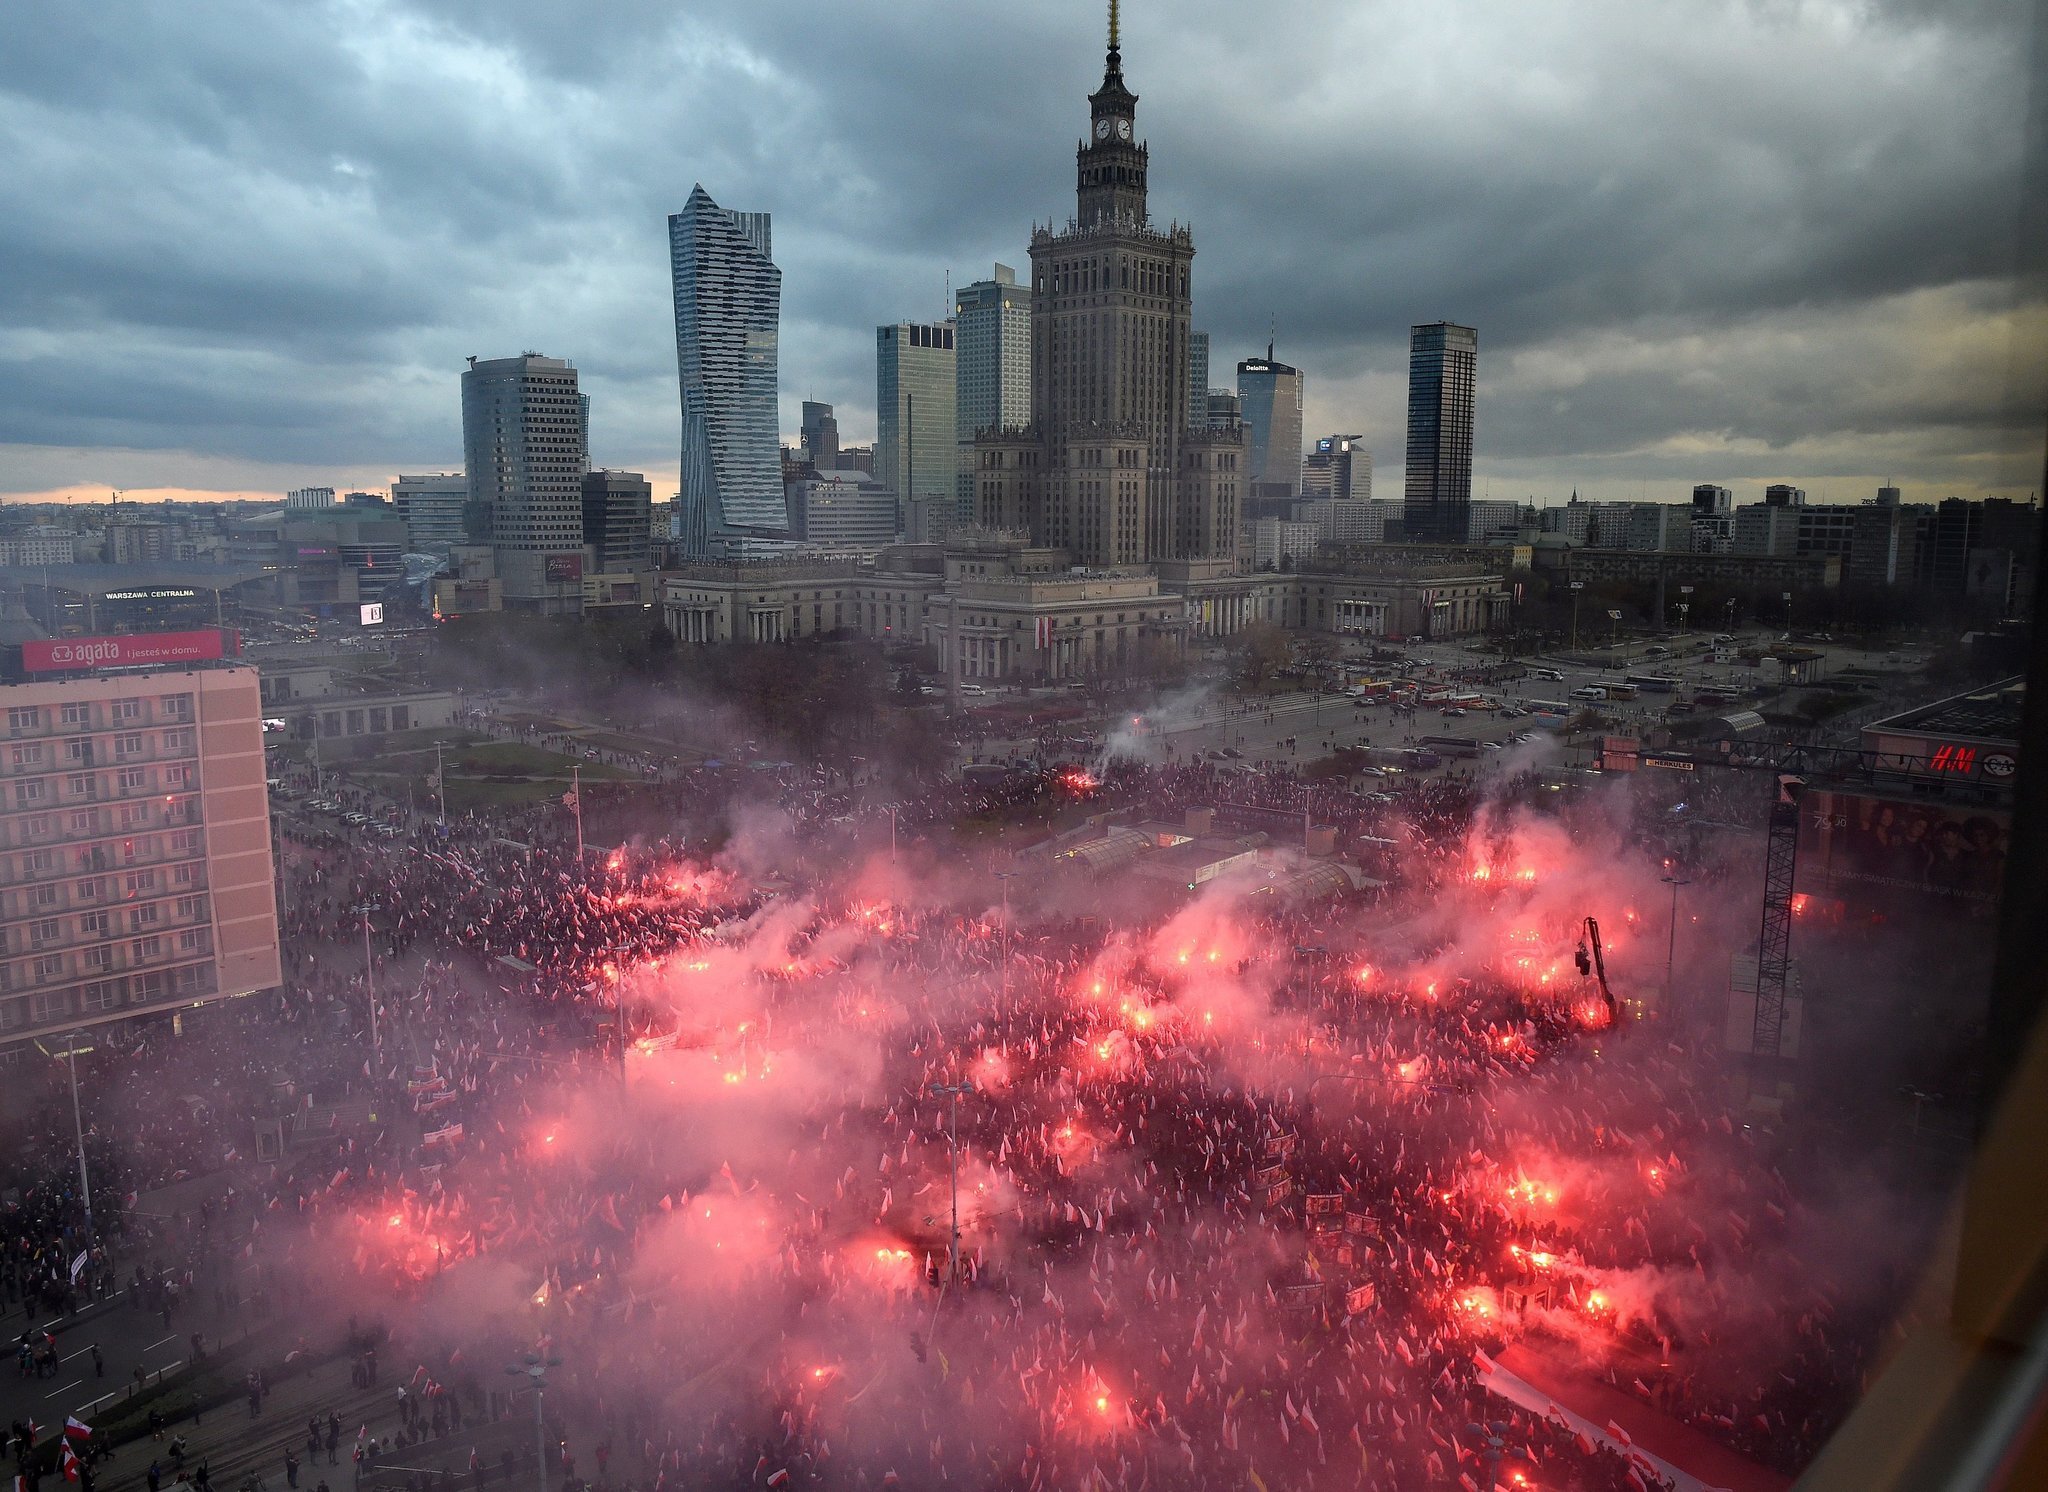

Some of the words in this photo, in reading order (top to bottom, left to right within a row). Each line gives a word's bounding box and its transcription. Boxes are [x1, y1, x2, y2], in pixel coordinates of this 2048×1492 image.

[106, 592, 148, 600] WARSZAWA
[151, 590, 194, 598] CENTRALNA
[75, 640, 119, 665] agata
[132, 649, 160, 659] jesteś
[171, 647, 201, 655] domu.
[1654, 758, 1692, 769] HERKULES
